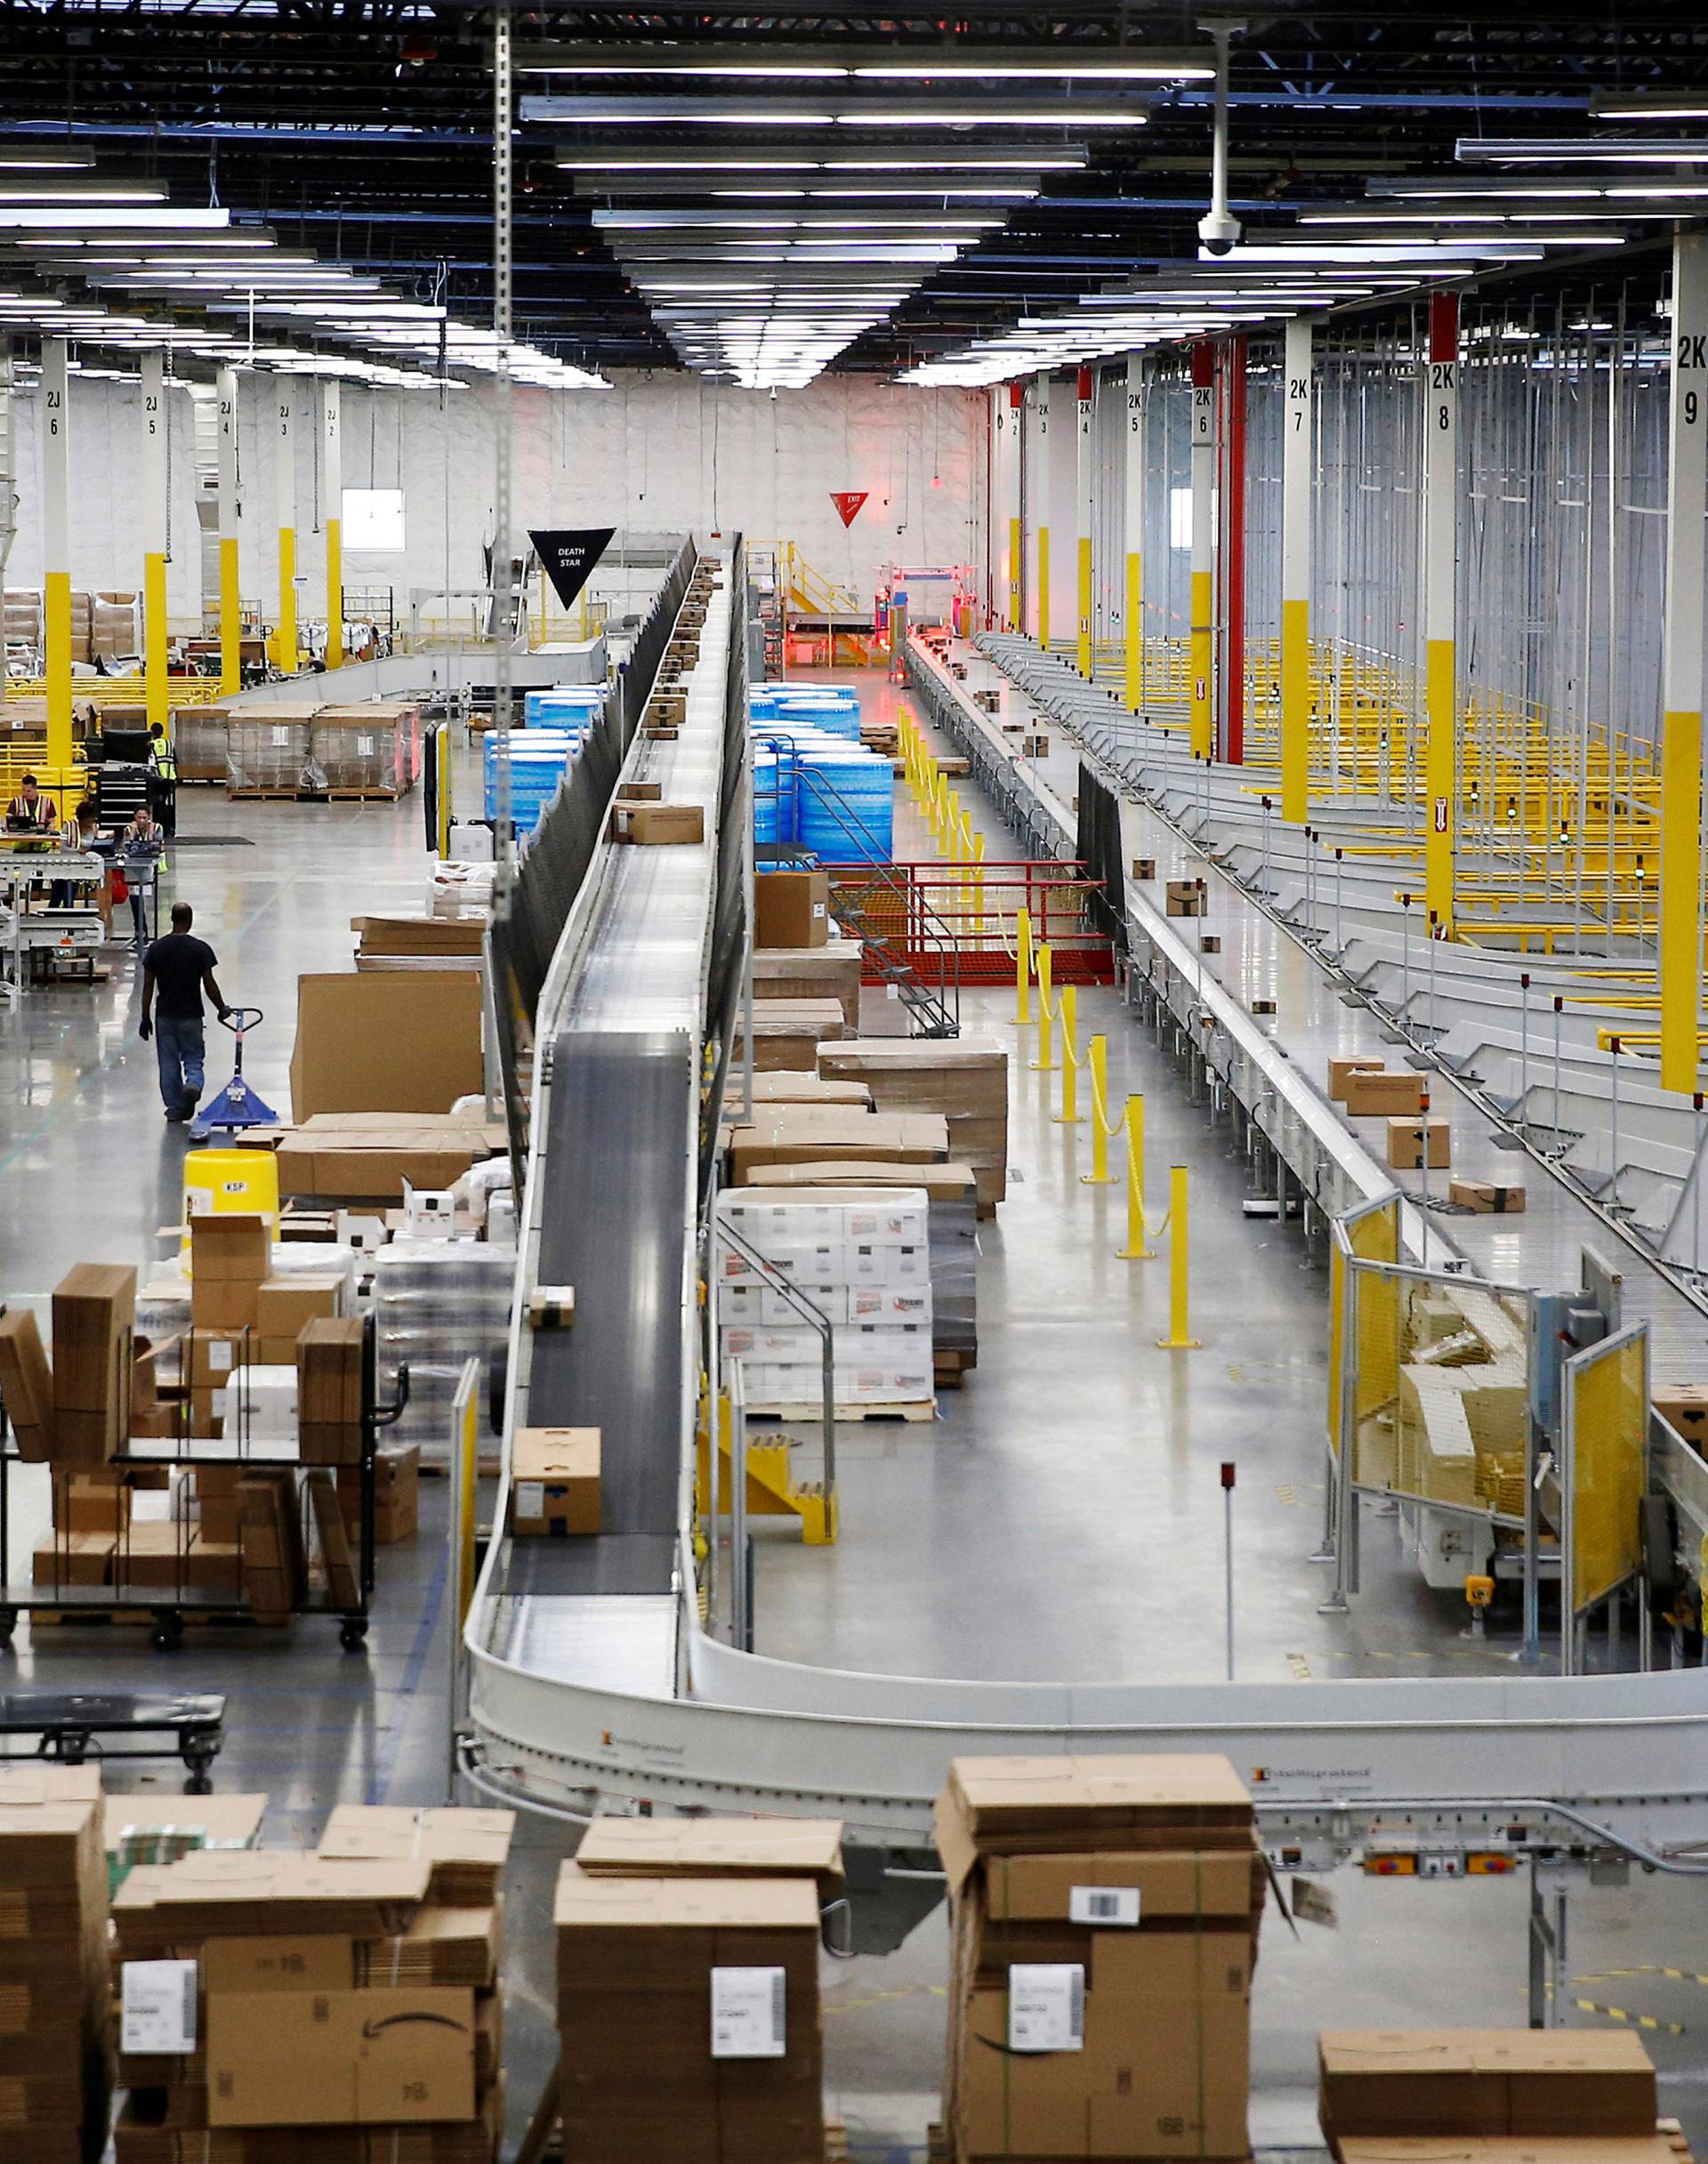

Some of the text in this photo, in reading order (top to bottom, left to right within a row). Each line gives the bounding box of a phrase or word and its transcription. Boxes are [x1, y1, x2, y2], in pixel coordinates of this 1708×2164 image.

[1678, 335, 1707, 369] 2K
[1432, 365, 1454, 389] 2K
[1290, 380, 1308, 399] 2K
[47, 391, 60, 408] 2J
[146, 396, 157, 412] 2J
[1128, 394, 1140, 409] 2K
[1196, 389, 1211, 406] 2K
[221, 401, 231, 414] 2J
[279, 406, 289, 418] 2J
[1039, 404, 1050, 415] 2K
[1080, 402, 1091, 414] 2K
[1684, 390, 1697, 425] 9
[327, 409, 336, 421] 2J
[1294, 412, 1303, 431] 7
[1439, 406, 1449, 430] 8
[51, 418, 58, 435] 6
[149, 420, 156, 434] 5
[223, 422, 229, 434] 4
[281, 423, 287, 435] 3
[329, 425, 334, 436] 2
[1041, 422, 1047, 434] 3
[1083, 422, 1088, 434] 4
[1132, 418, 1139, 432] 5
[1199, 416, 1207, 433] 6
[558, 547, 585, 556] DEATH
[560, 559, 581, 567] STAR
